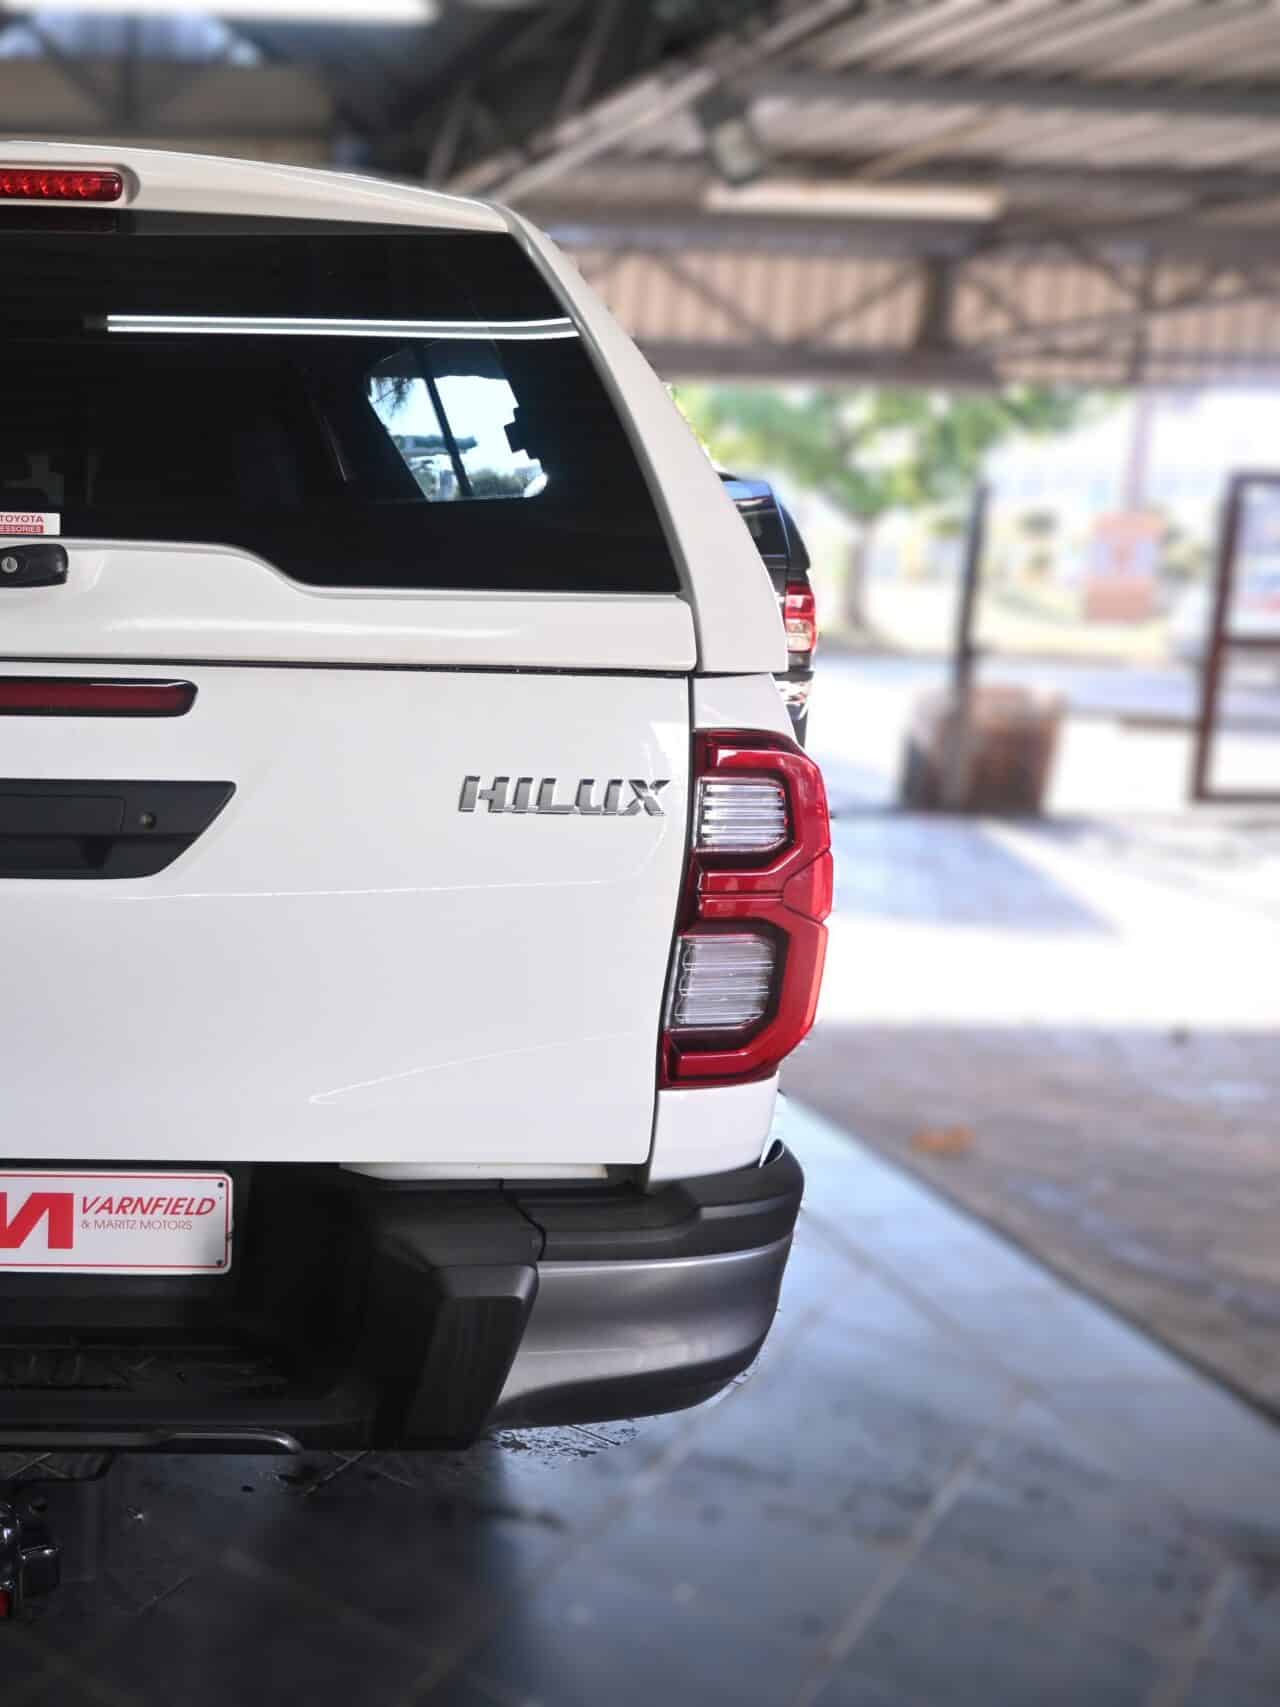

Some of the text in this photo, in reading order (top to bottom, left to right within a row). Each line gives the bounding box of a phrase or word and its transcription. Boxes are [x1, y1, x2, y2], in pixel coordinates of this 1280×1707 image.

[0, 515, 45, 523] TOYOTA
[458, 776, 671, 816] HILUX
[81, 1195, 216, 1216] VARNFIELD
[81, 1219, 192, 1231] & MARITZ MOTORS
